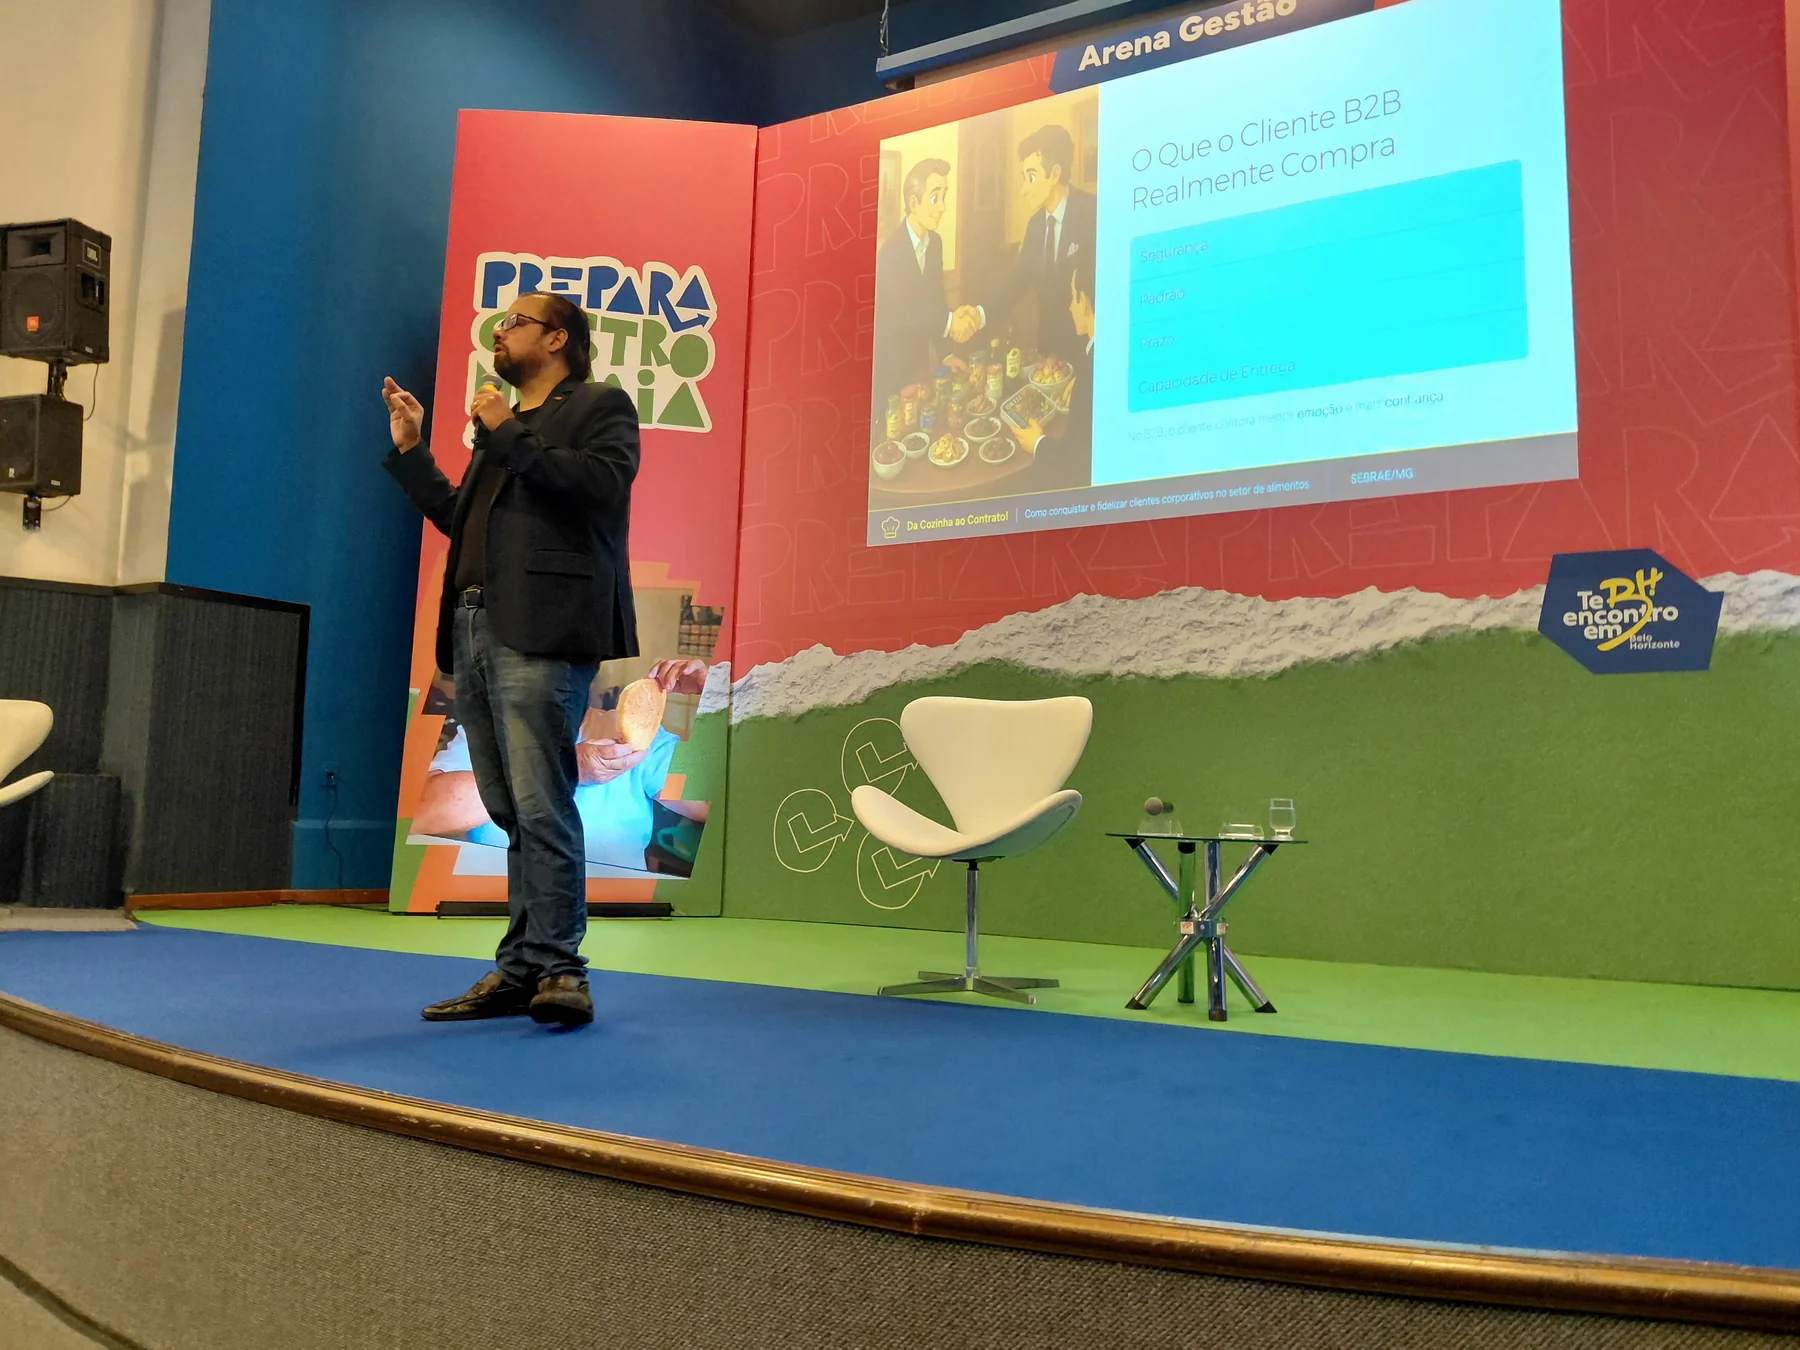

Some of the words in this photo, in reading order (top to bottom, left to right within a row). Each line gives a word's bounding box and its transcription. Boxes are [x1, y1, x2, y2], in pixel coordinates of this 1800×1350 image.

[1077, 30, 1171, 71] Arena
[1178, 0, 1297, 42] Gestão
[1132, 148, 1151, 172] O
[1158, 139, 1212, 168] Que
[1218, 134, 1233, 153] o
[1240, 109, 1336, 147] Cliente
[1344, 89, 1401, 124] B2B
[1133, 163, 1275, 211] Realmente
[1281, 137, 1395, 177] Compra
[1140, 241, 1209, 264] Segurança
[481, 261, 710, 333] PREPARA
[1139, 288, 1186, 306] Padrão
[1139, 335, 1175, 350] Prazo
[1138, 372, 1217, 394] Capacidade
[1220, 369, 1238, 382] de
[1241, 361, 1296, 380] Entrega
[1297, 403, 1344, 421] emoção
[1350, 467, 1414, 485] SEBRAE/MG
[1025, 508, 1047, 519] Como
[1048, 504, 1089, 519] conquistar
[1097, 499, 1128, 511] fidelizar
[1129, 495, 1160, 508] clientes
[1161, 489, 1214, 506] corporativos
[1216, 489, 1227, 498] no
[1229, 486, 1252, 497] setor
[1253, 484, 1265, 494] de
[1266, 479, 1310, 493] alimentos
[907, 520, 918, 531] Da
[920, 517, 954, 530] Cozinha
[955, 518, 966, 526] ao
[967, 511, 1009, 525] Contrato!
[1577, 590, 1604, 610] Te
[1563, 604, 1679, 627] encontro
[1584, 624, 1623, 640] em
[1629, 633, 1653, 642] Belo
[1629, 640, 1681, 650] Horizonte
